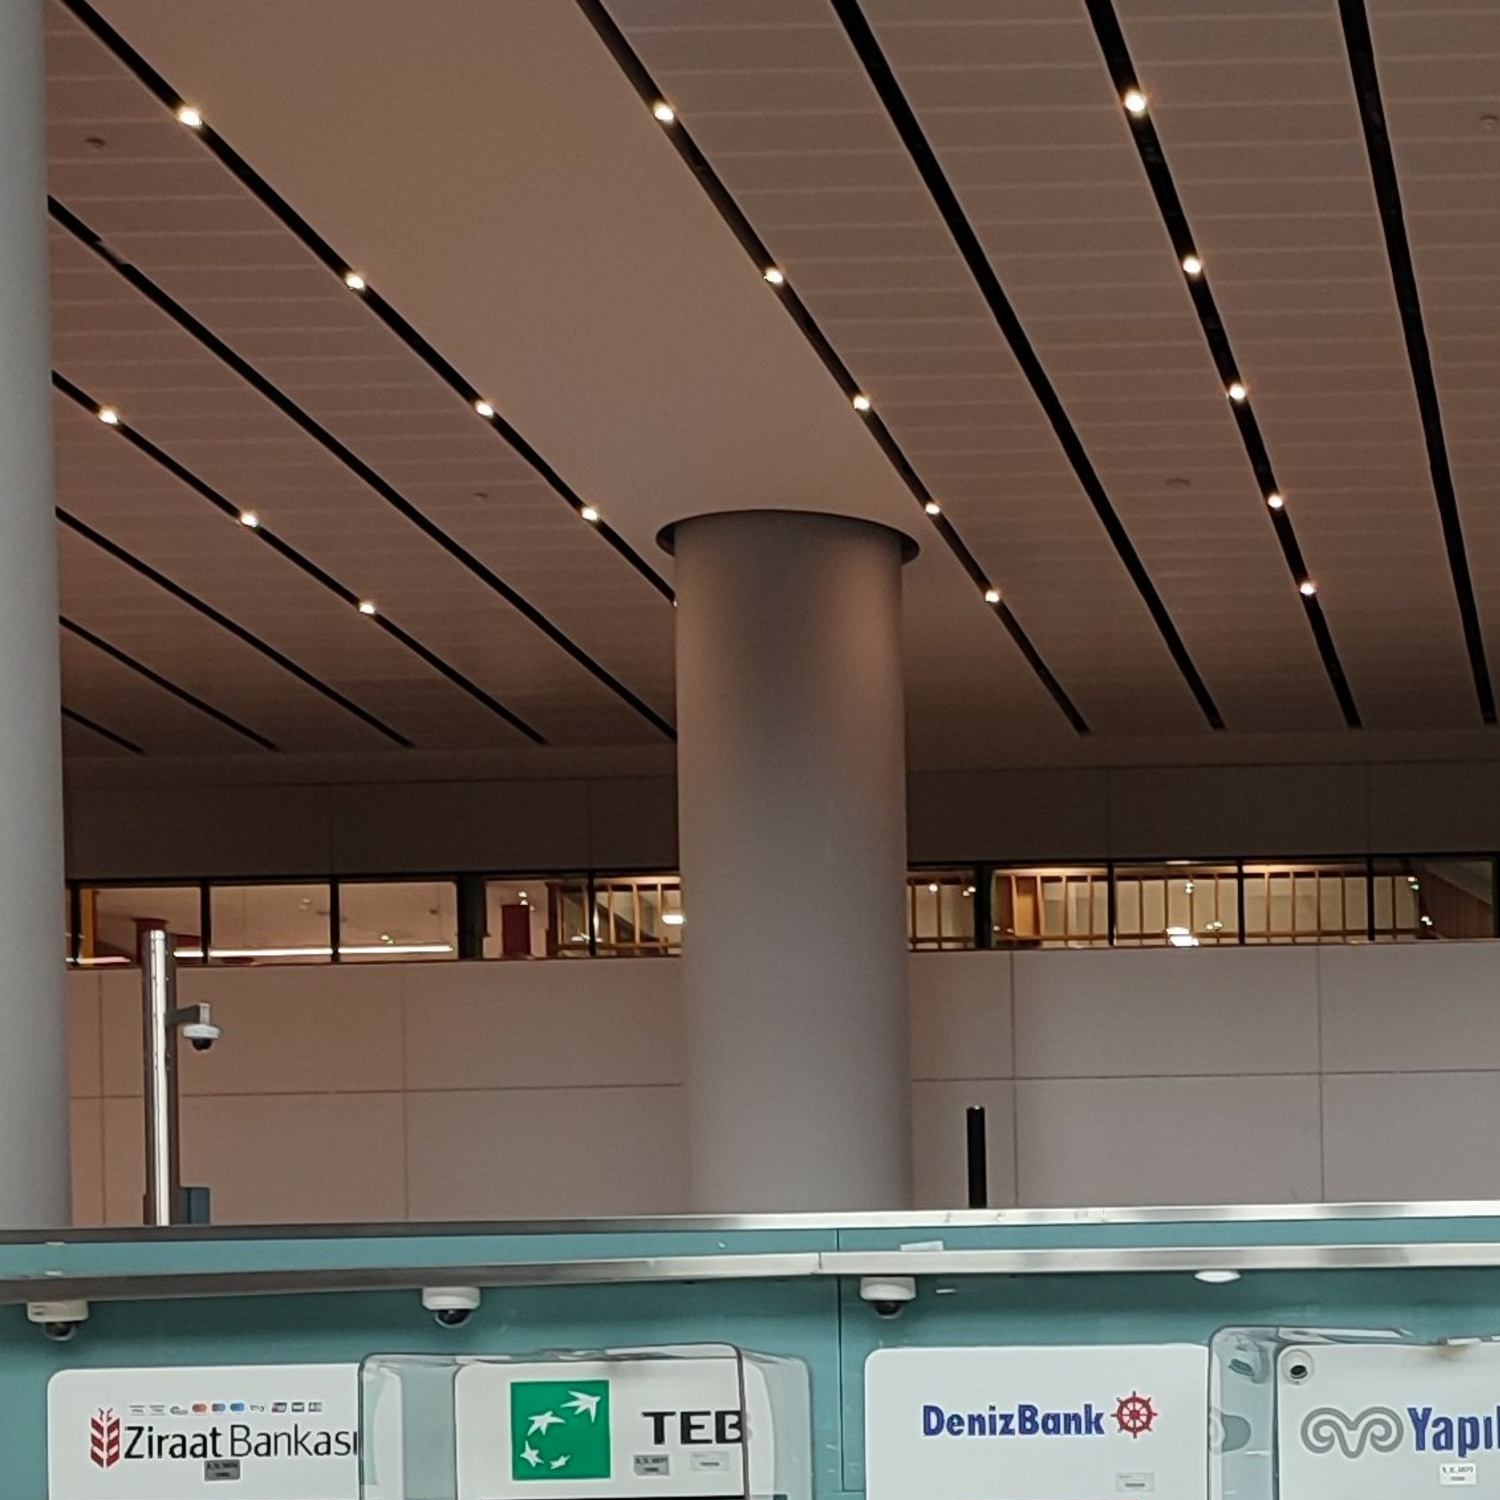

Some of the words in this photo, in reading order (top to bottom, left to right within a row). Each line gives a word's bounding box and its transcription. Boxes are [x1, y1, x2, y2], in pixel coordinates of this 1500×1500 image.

[641, 1410, 742, 1445] TEB
[922, 1404, 1105, 1437] DenizBank
[124, 1425, 223, 1459] Ziraat
[230, 1424, 358, 1457] Bankası
